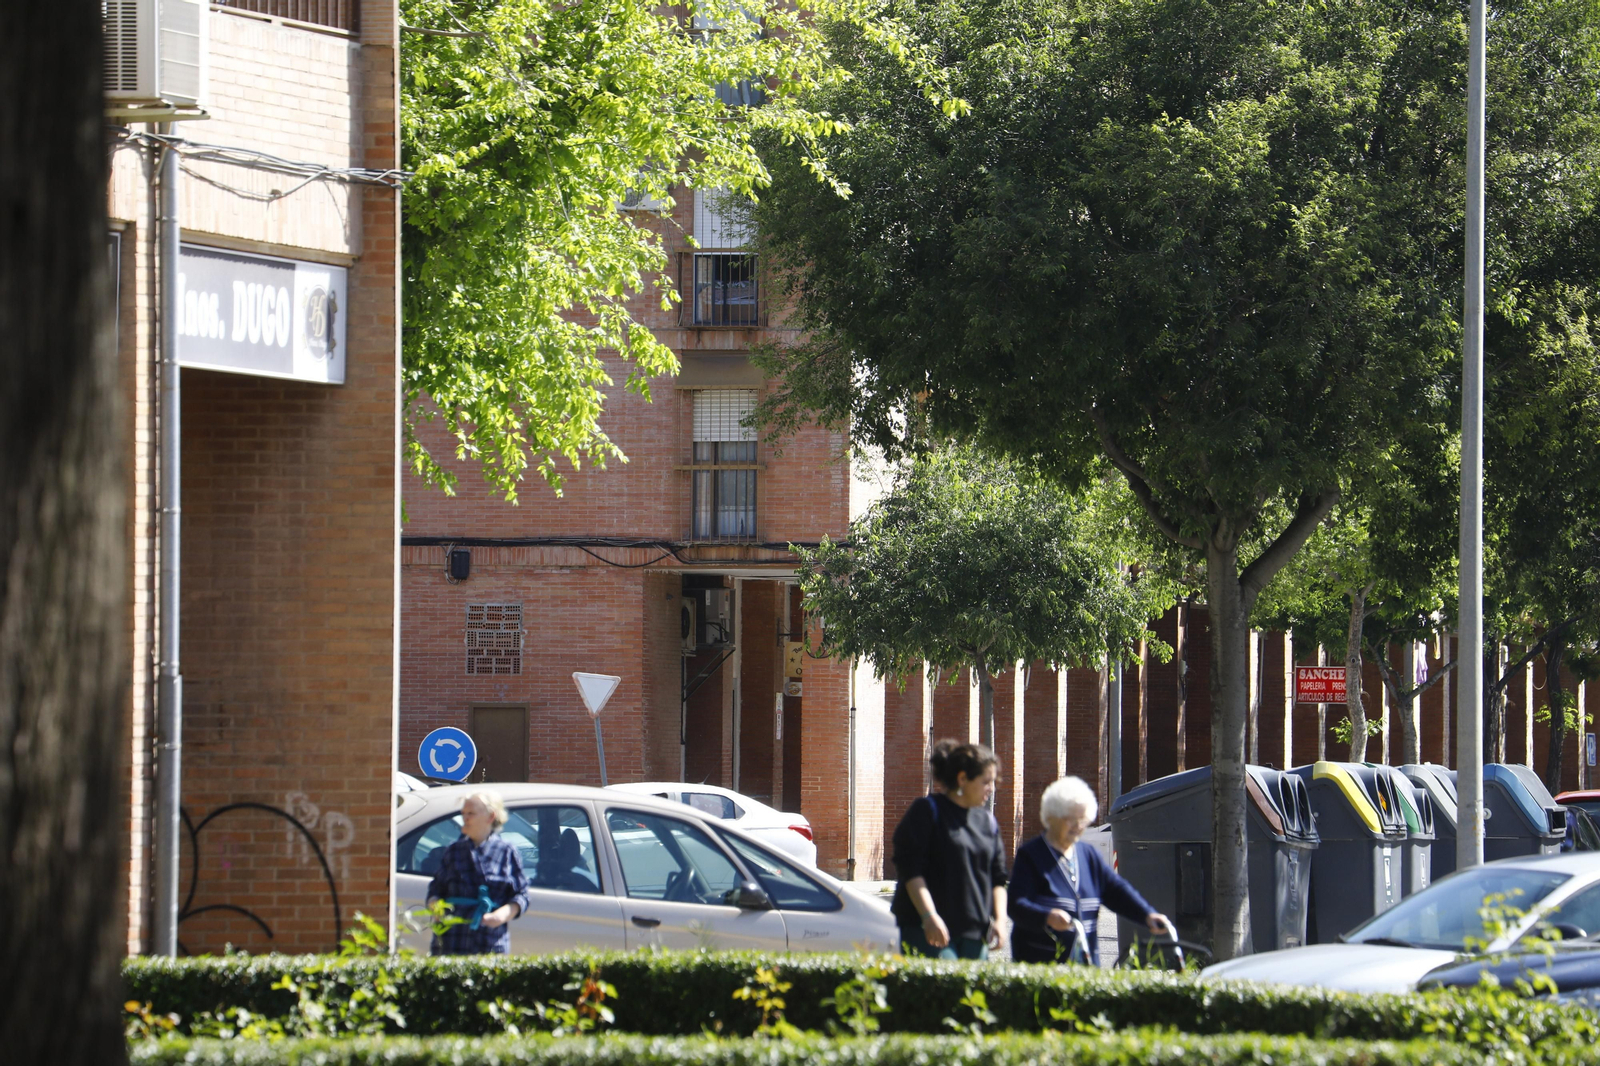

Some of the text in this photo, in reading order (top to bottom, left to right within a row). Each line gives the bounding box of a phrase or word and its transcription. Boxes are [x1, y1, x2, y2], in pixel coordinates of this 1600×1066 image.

[231, 279, 291, 348] DUGO
[1299, 669, 1346, 680] SANCHE
[1300, 681, 1326, 690] PAPELERIA
[1298, 692, 1325, 701] ARTICULOS
[1326, 692, 1334, 701] DE
